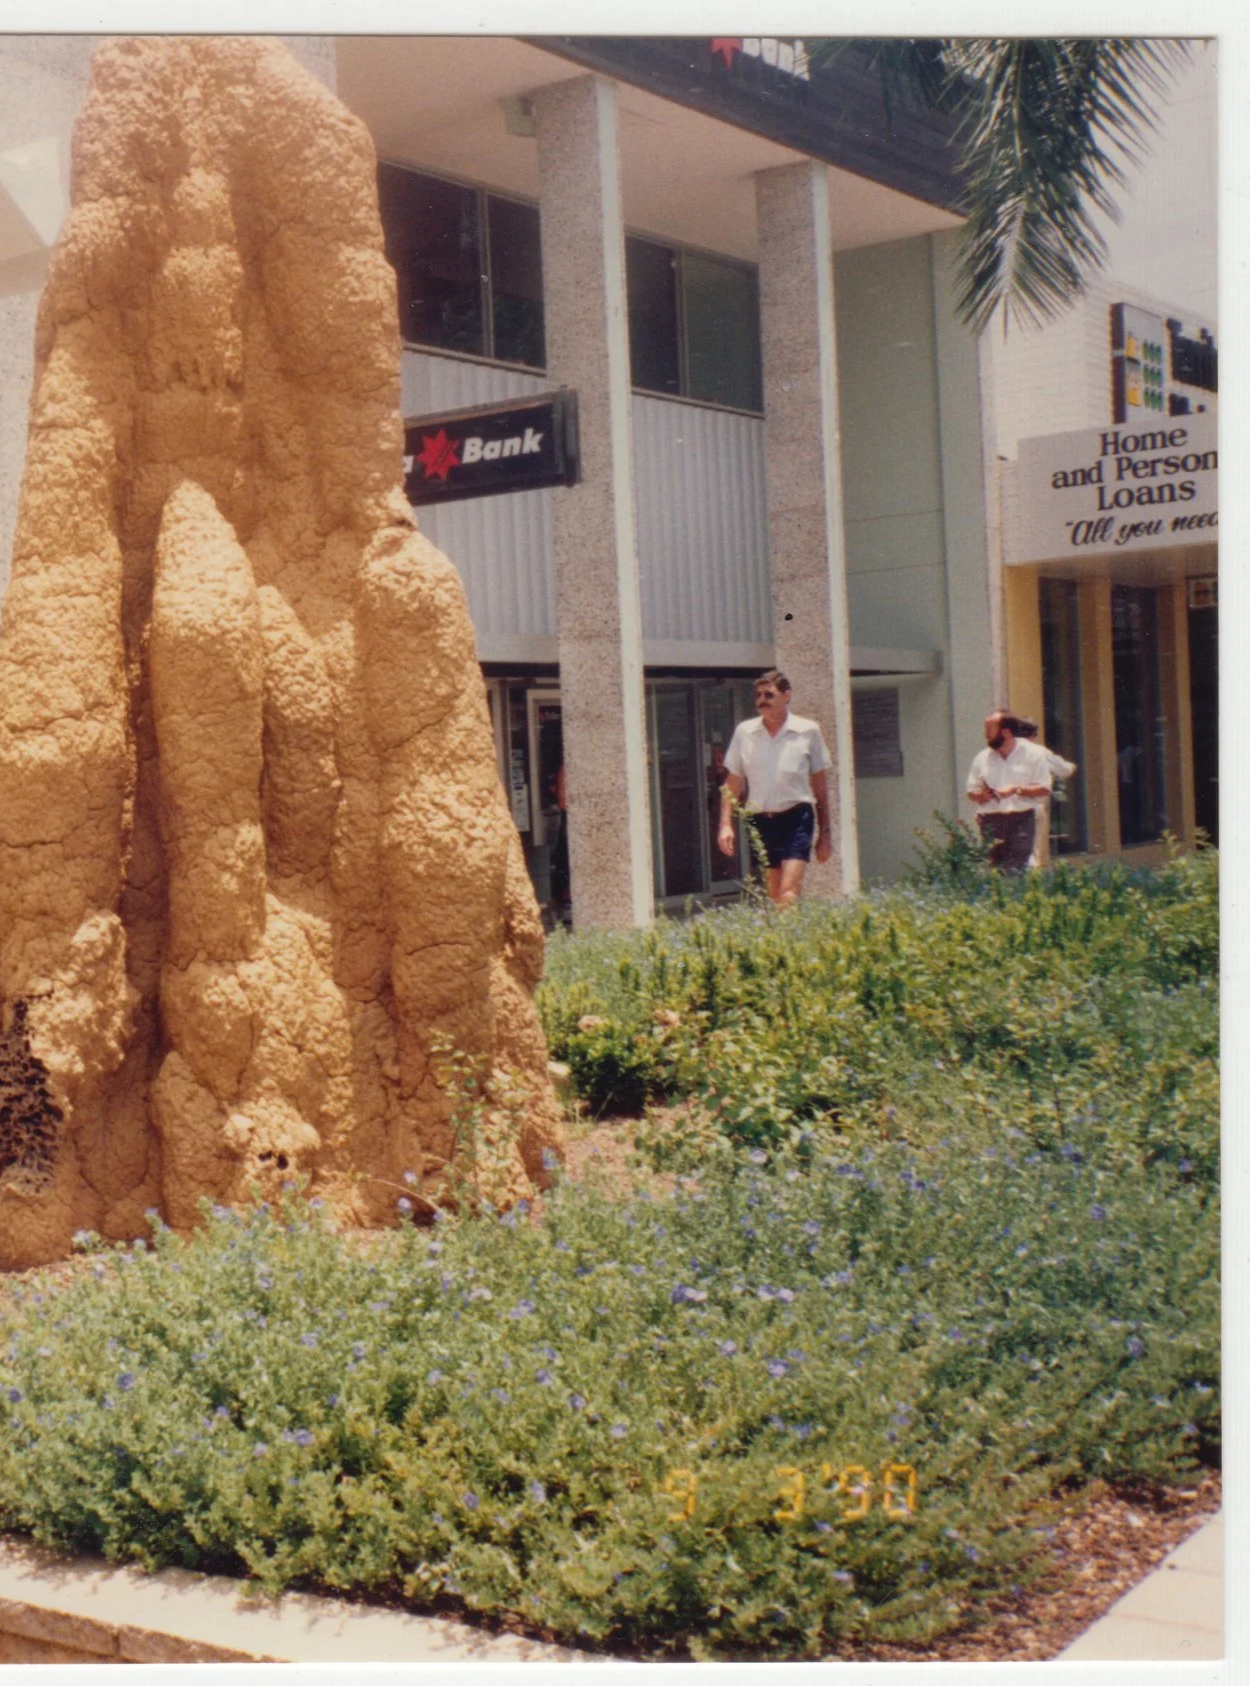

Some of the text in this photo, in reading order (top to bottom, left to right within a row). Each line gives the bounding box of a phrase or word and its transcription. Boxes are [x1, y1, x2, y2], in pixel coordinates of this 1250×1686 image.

[461, 426, 544, 465] Bank
[1098, 427, 1188, 457] Home
[1051, 459, 1105, 490] and
[1096, 479, 1197, 512] Loans
[1114, 517, 1165, 546] you
